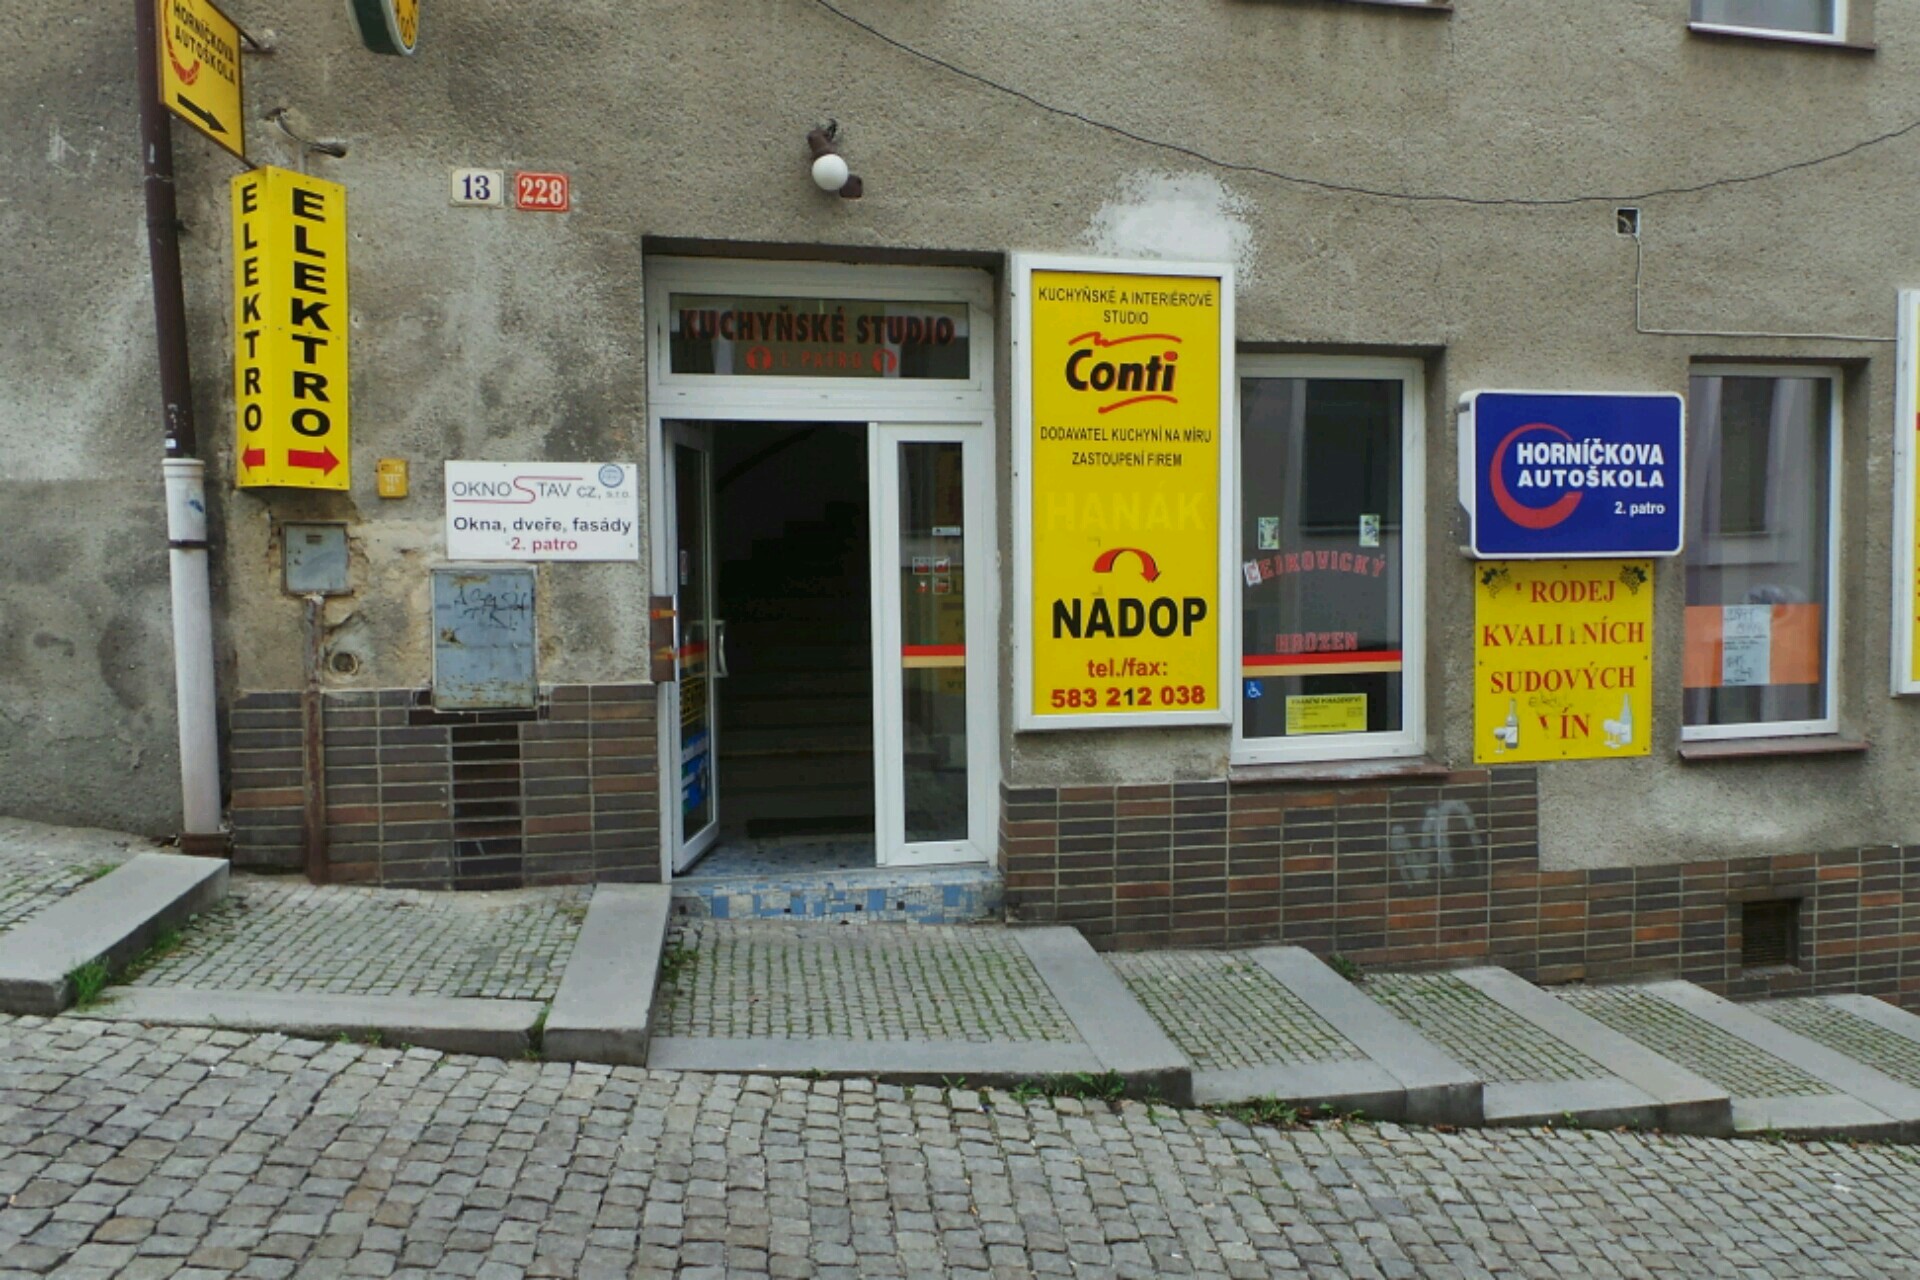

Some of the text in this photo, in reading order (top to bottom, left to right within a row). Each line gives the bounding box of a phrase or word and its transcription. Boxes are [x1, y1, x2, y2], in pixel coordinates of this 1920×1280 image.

[175, 24, 236, 86] AUTOŠKOLA
[462, 173, 491, 200] 13
[521, 177, 563, 206] 228
[242, 183, 262, 432] ELEKTRO
[1038, 285, 1213, 307] KUCHYŇSKÉ A INTERIÉROVÉ
[291, 187, 331, 438] ELEKTRO
[1103, 309, 1149, 325] STUDIO
[678, 305, 957, 346] KUCHYŇSKÉ STUDIO
[1065, 349, 1178, 391] Conti
[1040, 425, 1212, 443] DODAVATEL KUCHYNÍ NA MÍRU
[1072, 449, 1183, 467] ZASTOUPENÍ FIREM
[1516, 438, 1665, 466] HORNÍČKOVA
[1516, 466, 1665, 488] AUTOŠKOLA
[1613, 501, 1666, 518] 2. patro
[453, 516, 632, 536] Okna, dveře, fasády
[511, 537, 578, 554] 2. patro
[1514, 579, 1617, 604] RODEJ
[1052, 597, 1207, 639] NADOP
[1275, 631, 1358, 653] HROZEN
[1087, 658, 1169, 678] tel./fax:
[1490, 661, 1637, 694] SUDOVÝCH
[1050, 685, 1206, 708] 583 212 038
